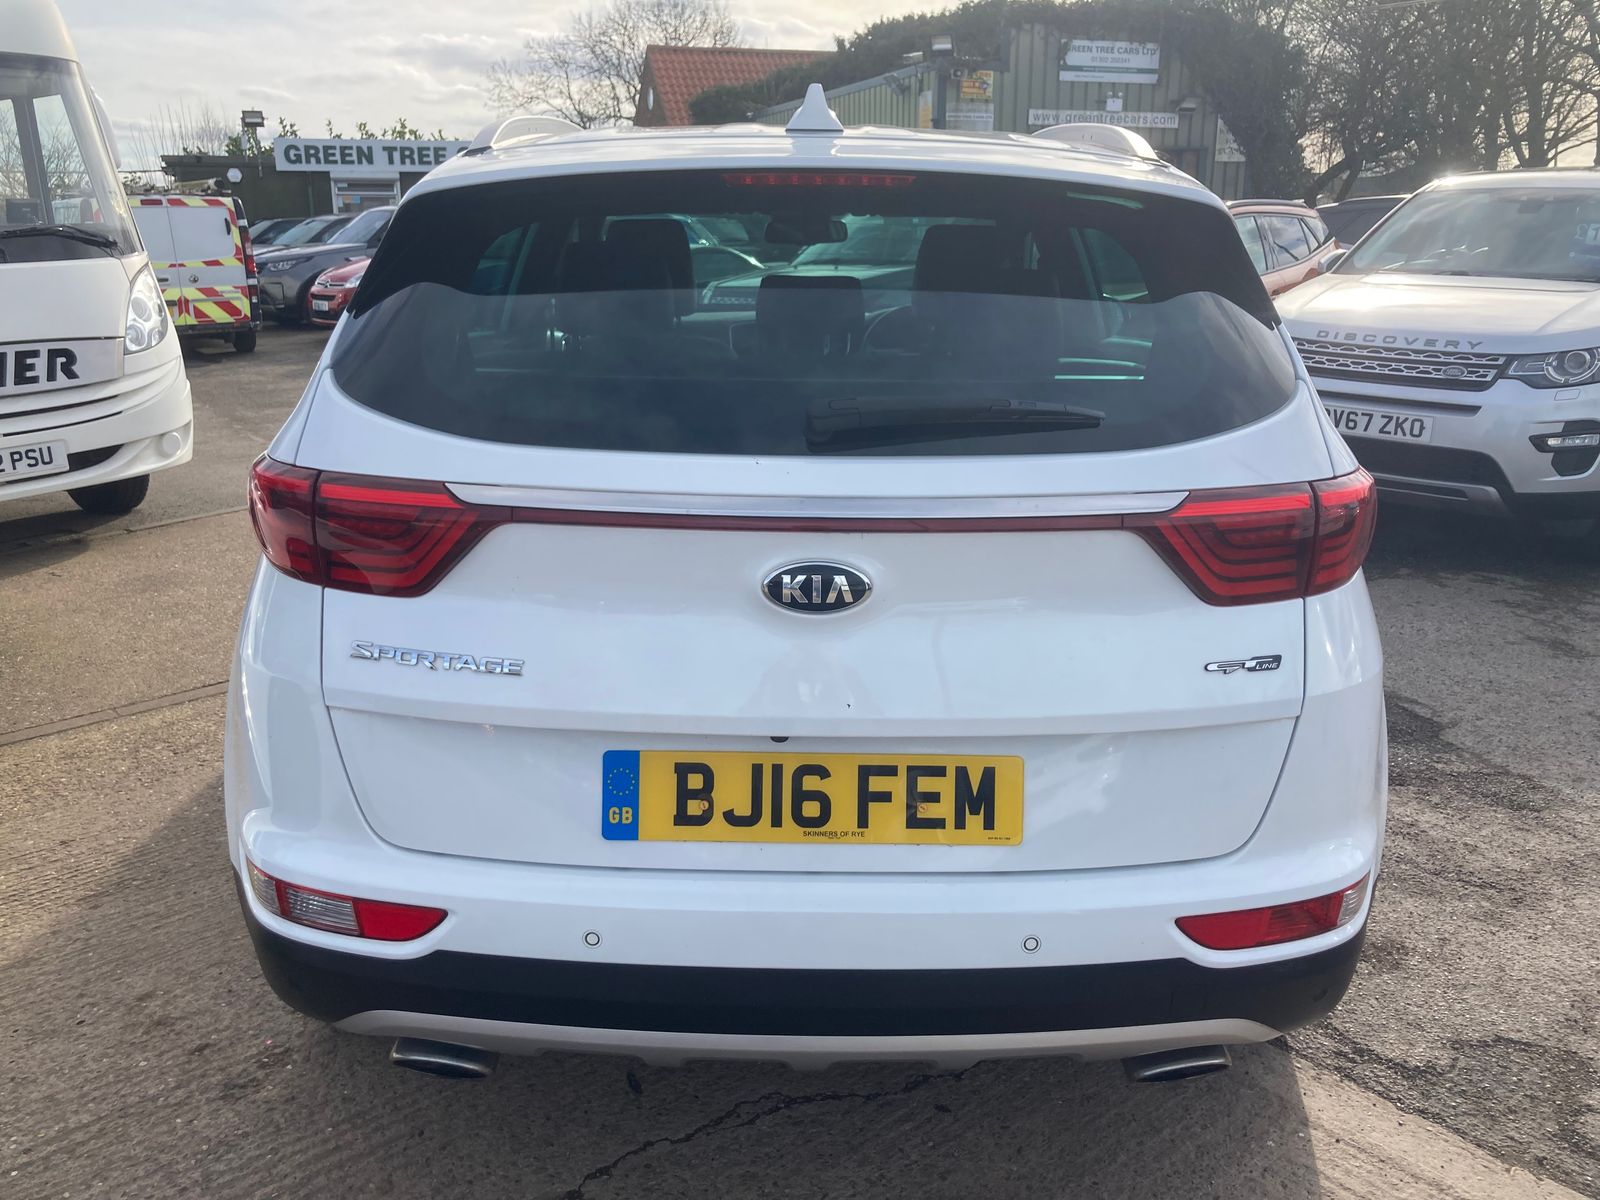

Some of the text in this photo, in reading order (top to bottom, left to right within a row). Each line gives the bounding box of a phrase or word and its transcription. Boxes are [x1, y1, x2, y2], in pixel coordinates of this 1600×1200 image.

[1068, 44, 1093, 54] REEN
[1095, 45, 1115, 54] TREE
[1117, 46, 1139, 56] CARS
[1032, 111, 1177, 126] www.greentreecars.com
[283, 144, 447, 166] GREEN TREE
[1316, 329, 1483, 350] DISCOVERY
[1378, 414, 1425, 438] ZKO
[10, 446, 53, 470] PSU
[781, 574, 854, 603] KIA
[349, 639, 526, 676] SPORTAGE
[1255, 661, 1279, 671] LINE
[672, 761, 996, 831] BJ16 FEM
[609, 806, 633, 824] GB
[803, 830, 838, 838] SKINNERS
[839, 830, 849, 838] OF
